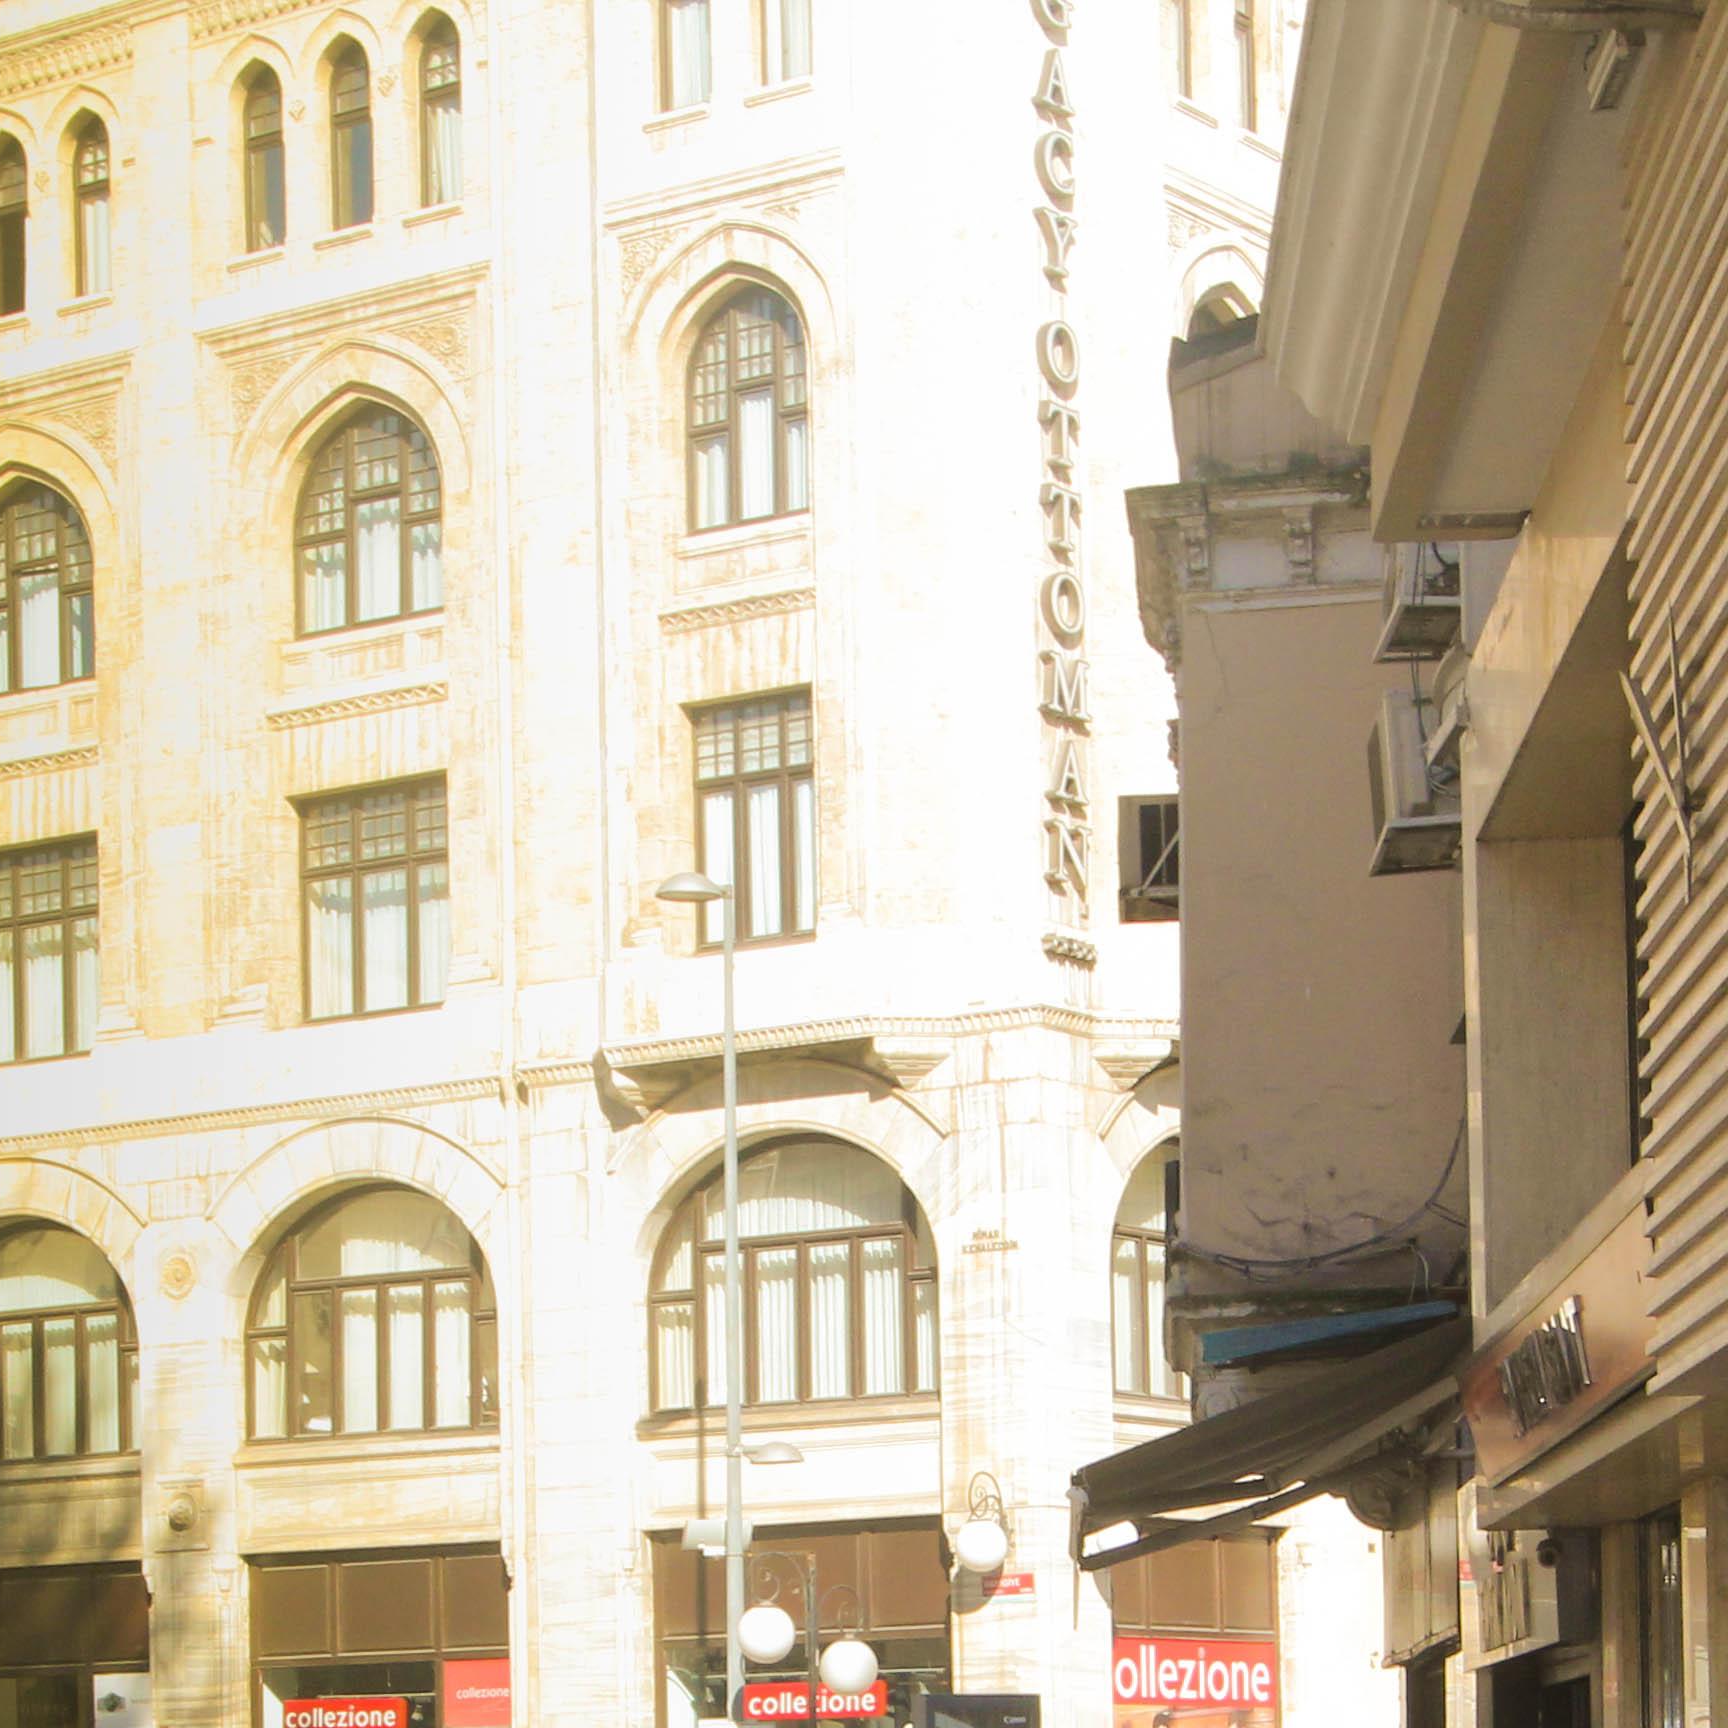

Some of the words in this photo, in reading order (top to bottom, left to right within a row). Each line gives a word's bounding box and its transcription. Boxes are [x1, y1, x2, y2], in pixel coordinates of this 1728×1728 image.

[1037, 320, 1092, 902] OTTOMAN
[456, 1686, 510, 1700] collezione
[748, 1688, 876, 1716] colleione
[285, 1704, 397, 1728] collezione
